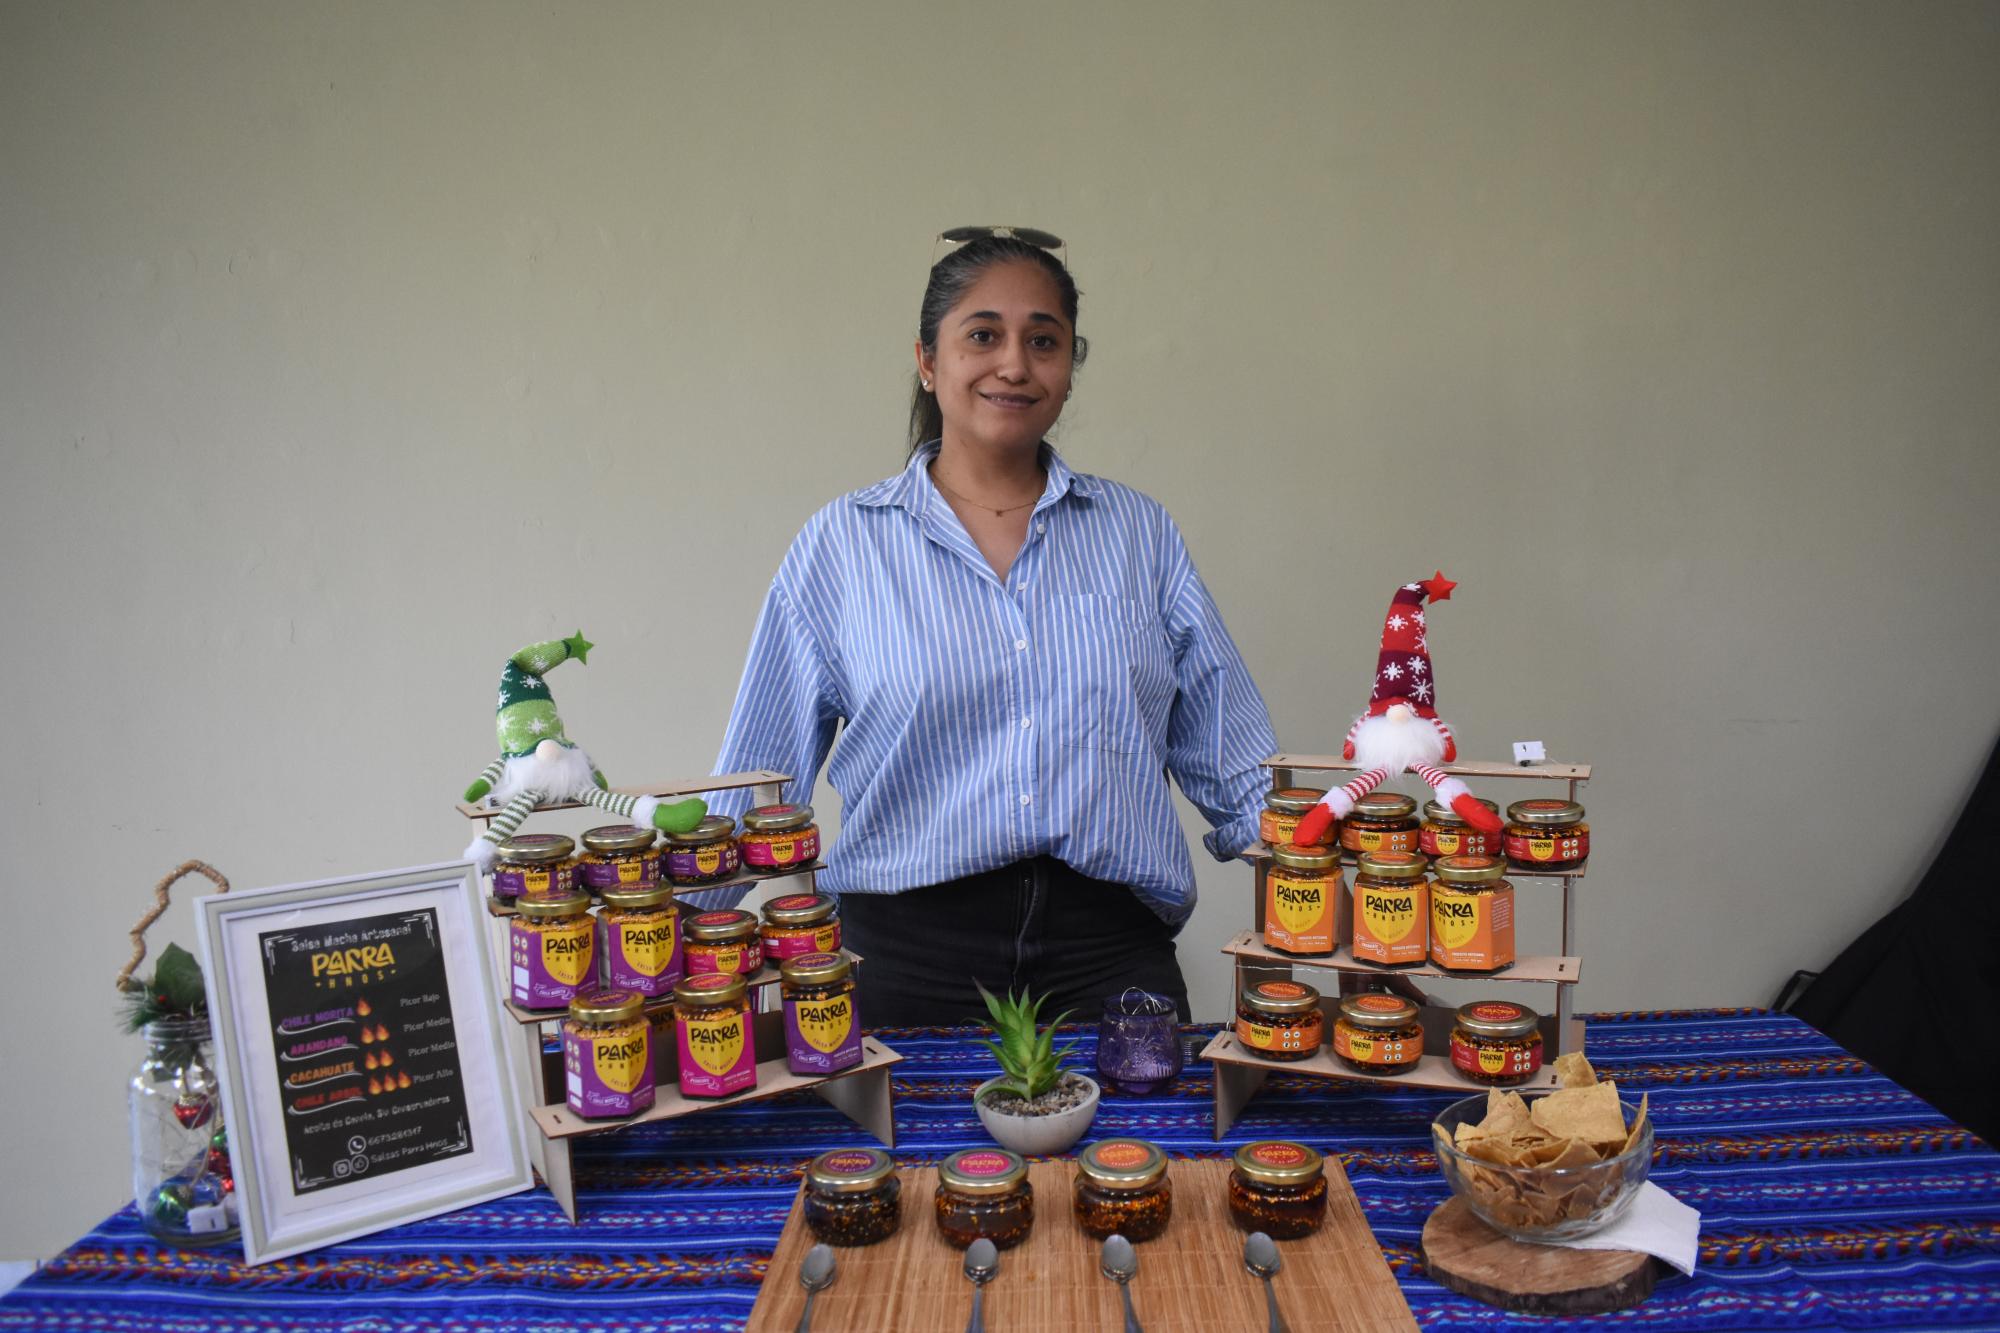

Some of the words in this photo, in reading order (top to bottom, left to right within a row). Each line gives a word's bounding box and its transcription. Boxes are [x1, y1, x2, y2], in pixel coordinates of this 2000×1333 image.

[1277, 885, 1321, 904] PARRA
[1366, 895, 1413, 913] PARRA
[1434, 898, 1474, 918] PARRA
[324, 933, 358, 948] Macha
[361, 923, 412, 941] Artesanal
[546, 932, 591, 954] PARRA
[625, 925, 671, 945] PARRA
[312, 943, 396, 977] PARRA
[328, 969, 384, 989] HNOS
[282, 1014, 312, 1028] CHILE
[314, 1007, 353, 1022] MORITA
[801, 1001, 848, 1023] PARRA
[403, 1022, 425, 1032] Picor
[426, 1016, 452, 1028] Medio
[691, 1023, 740, 1044] PARRA
[290, 1035, 348, 1056] ARANDANO
[408, 1047, 429, 1057] Picor
[430, 1041, 455, 1052] Medio
[598, 1037, 644, 1061] PARRA
[1480, 1052, 1503, 1062] PARRA
[289, 1061, 355, 1083] CACAHUATE
[402, 1144, 425, 1156] Parra
[1256, 1149, 1300, 1157] PARRA
